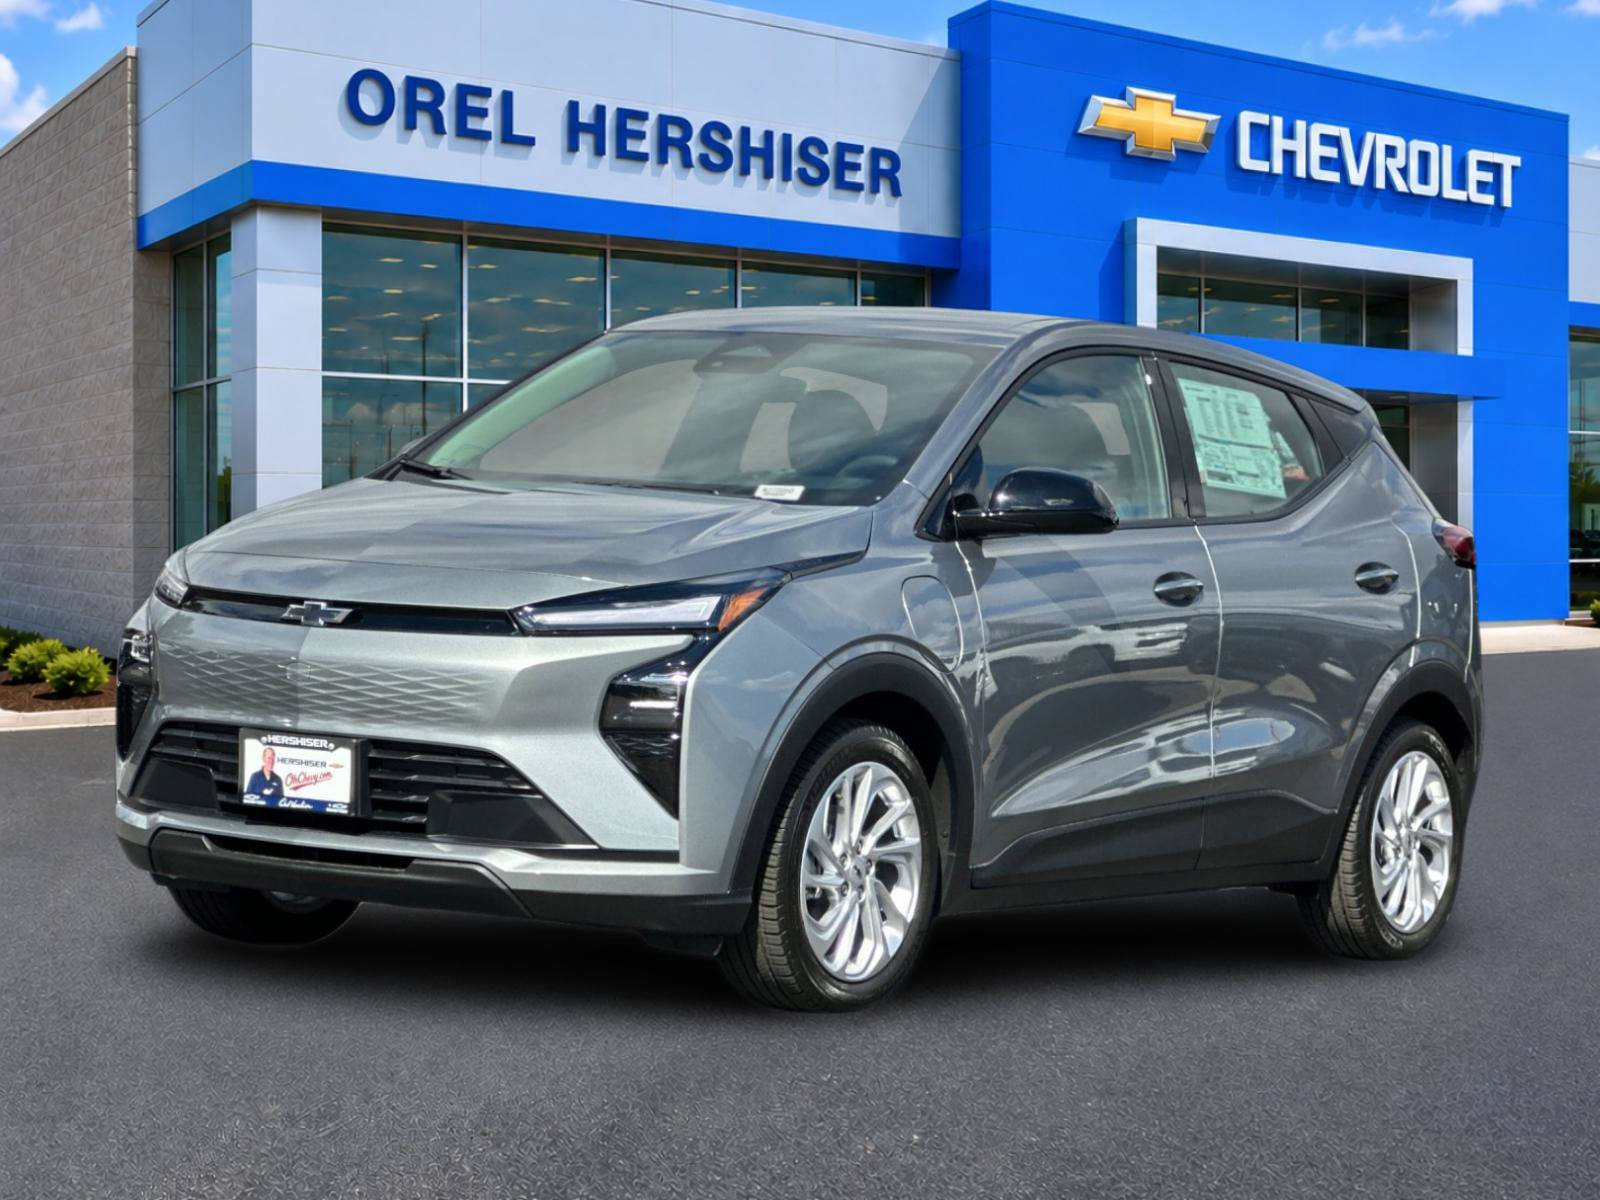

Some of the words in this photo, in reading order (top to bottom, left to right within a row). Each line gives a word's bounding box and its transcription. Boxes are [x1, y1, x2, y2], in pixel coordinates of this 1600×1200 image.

[347, 68, 535, 146] OREL
[567, 99, 902, 197] HERSHISER
[1236, 110, 1521, 208] CHEVROLET
[267, 734, 328, 748] HERSHISER
[277, 757, 327, 769] HERSHISER
